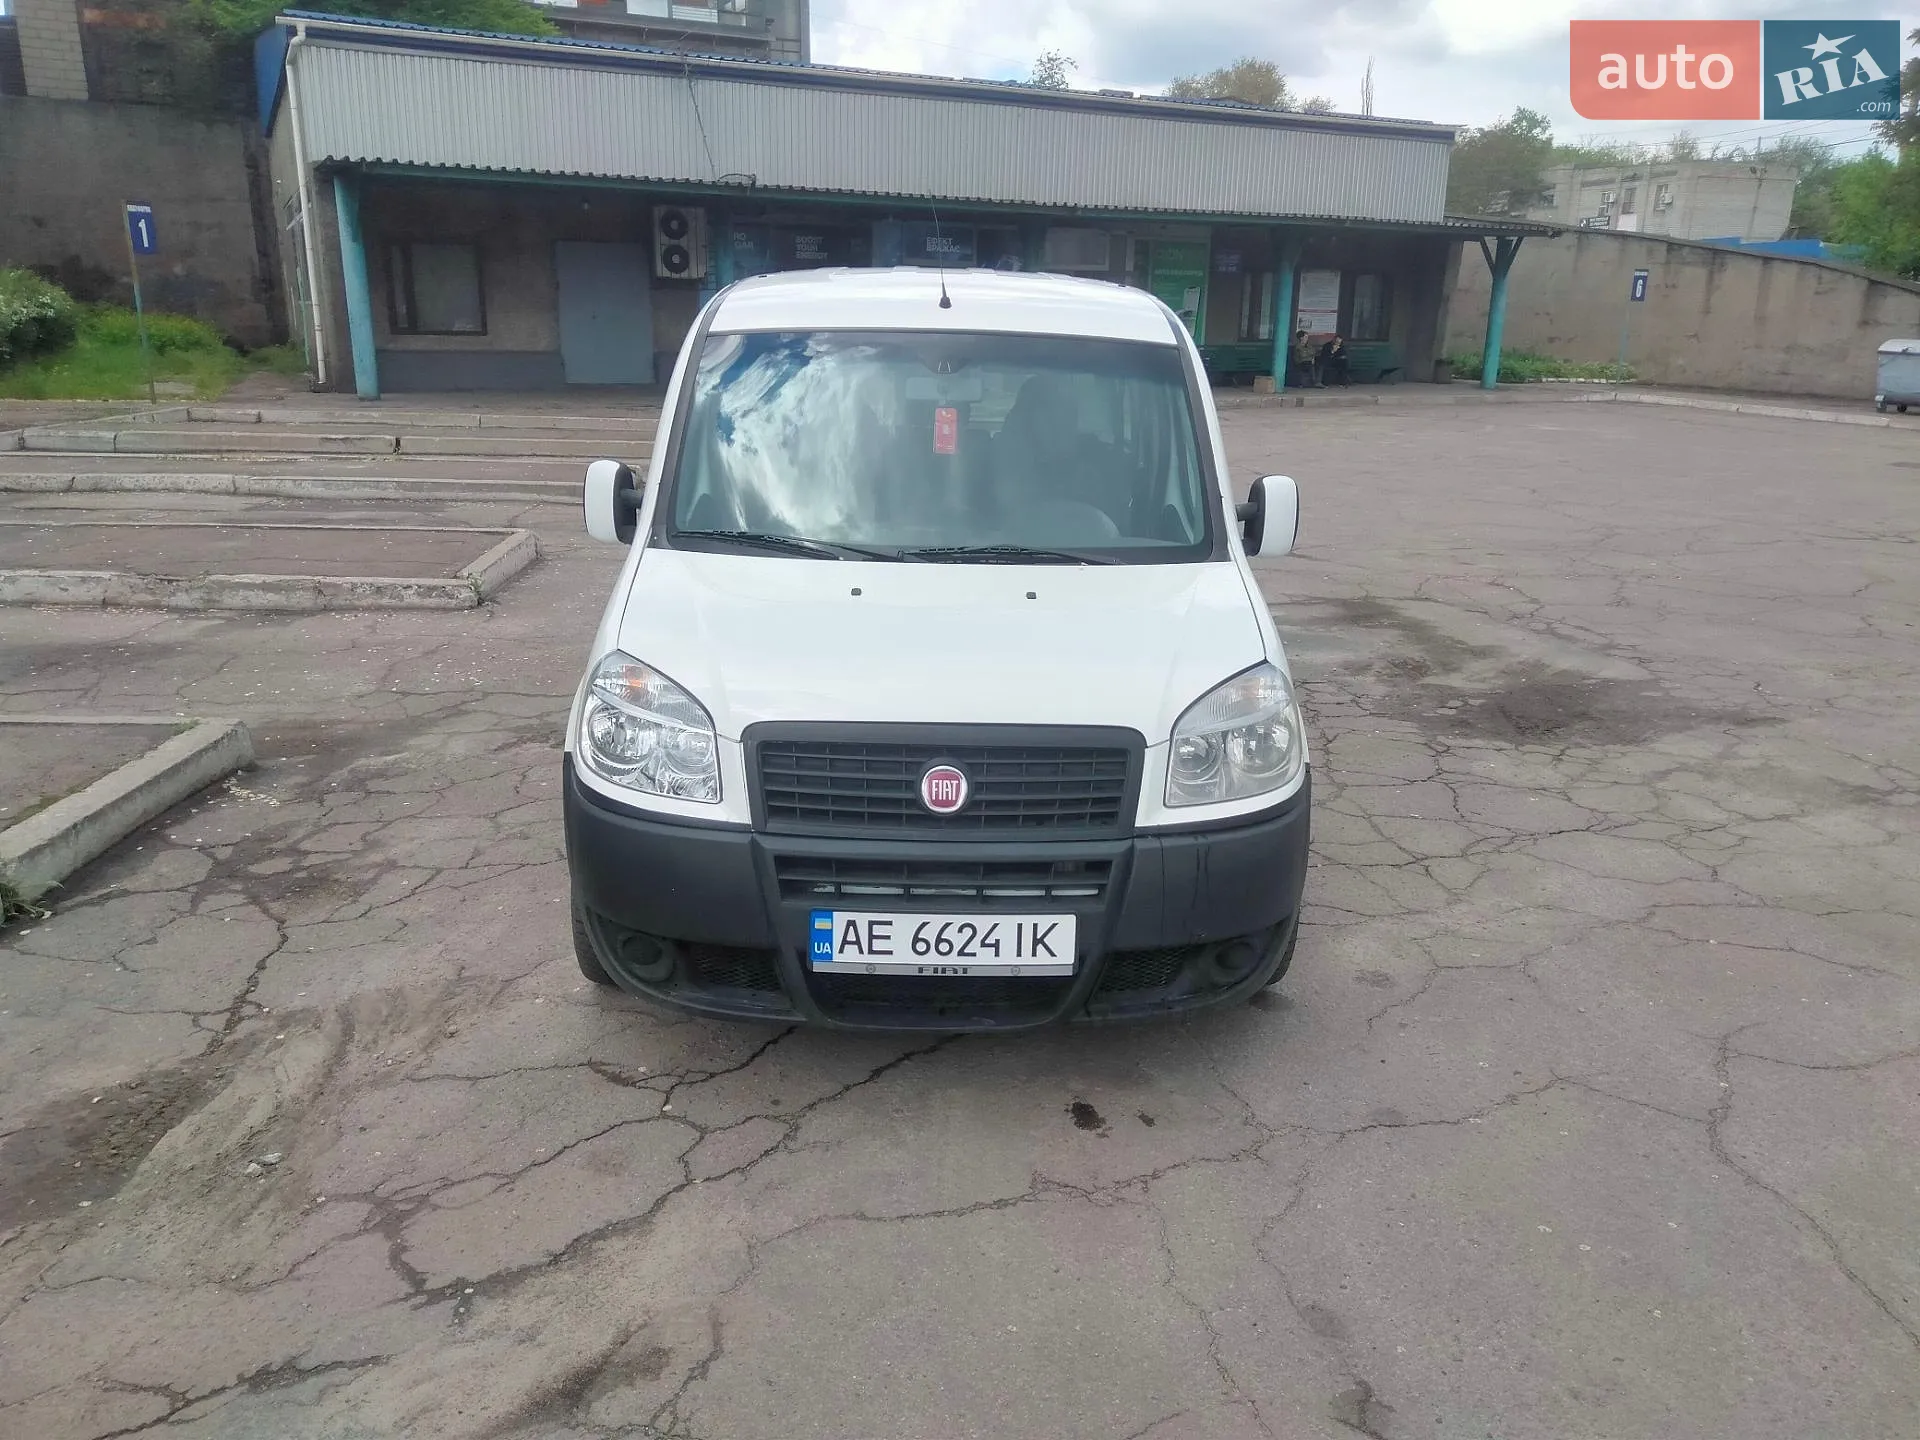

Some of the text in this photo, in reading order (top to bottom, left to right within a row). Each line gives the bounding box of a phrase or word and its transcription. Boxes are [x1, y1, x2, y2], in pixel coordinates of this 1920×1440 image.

[138, 218, 149, 248] 1
[1635, 279, 1644, 298] 6
[931, 779, 959, 801] FIAT
[814, 942, 832, 954] UA
[838, 919, 1059, 958] AE 6624 IK
